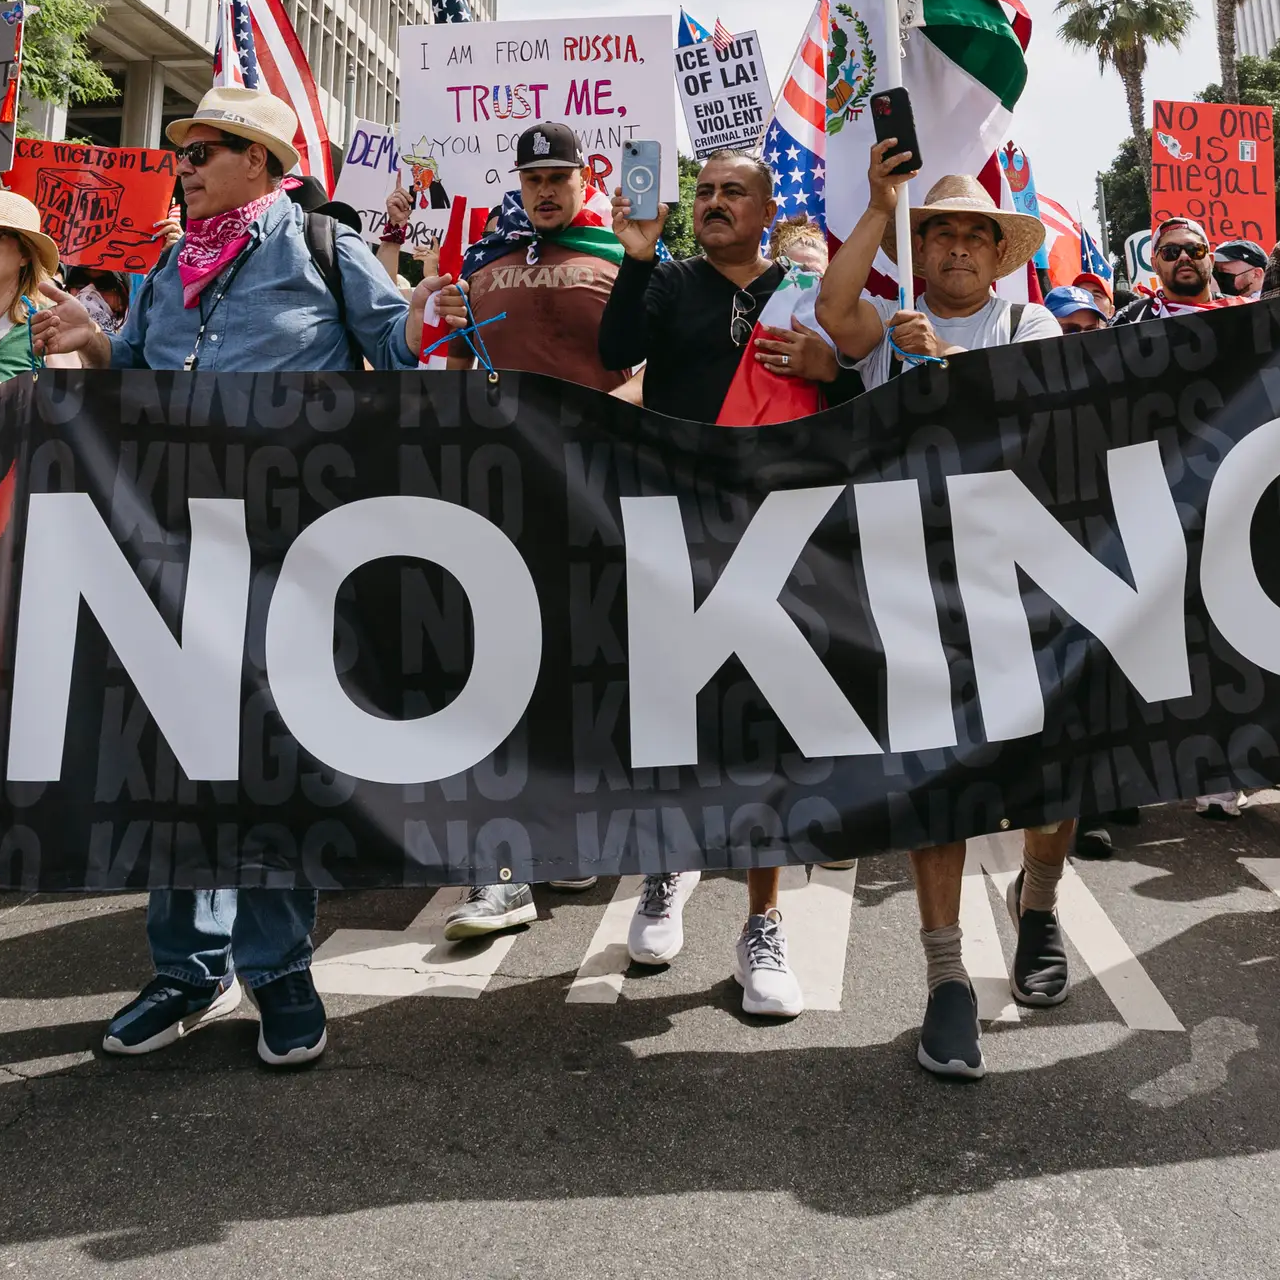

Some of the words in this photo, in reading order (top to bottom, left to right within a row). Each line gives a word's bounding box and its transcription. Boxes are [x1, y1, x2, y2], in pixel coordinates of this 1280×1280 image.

[421, 42, 429, 69] I
[447, 45, 472, 66] AM
[496, 39, 550, 64] FROM
[564, 33, 645, 65] RUSSIA,
[675, 48, 710, 72] ICE
[715, 37, 754, 63] OUT
[684, 71, 713, 97] OF
[720, 61, 759, 88] LA!
[447, 84, 549, 122] TRUST
[564, 79, 627, 118] ME,
[694, 99, 724, 118] END
[728, 92, 757, 110] THE
[694, 130, 741, 148] CRIMINAL
[743, 123, 767, 137] RAI
[697, 107, 763, 135] VIOLENT
[433, 135, 481, 156] YOU
[575, 124, 641, 149] WANT
[1195, 136, 1228, 163] IS
[140, 152, 174, 176] LA
[488, 267, 595, 292] XIKANO
[7, 492, 542, 785] NO
